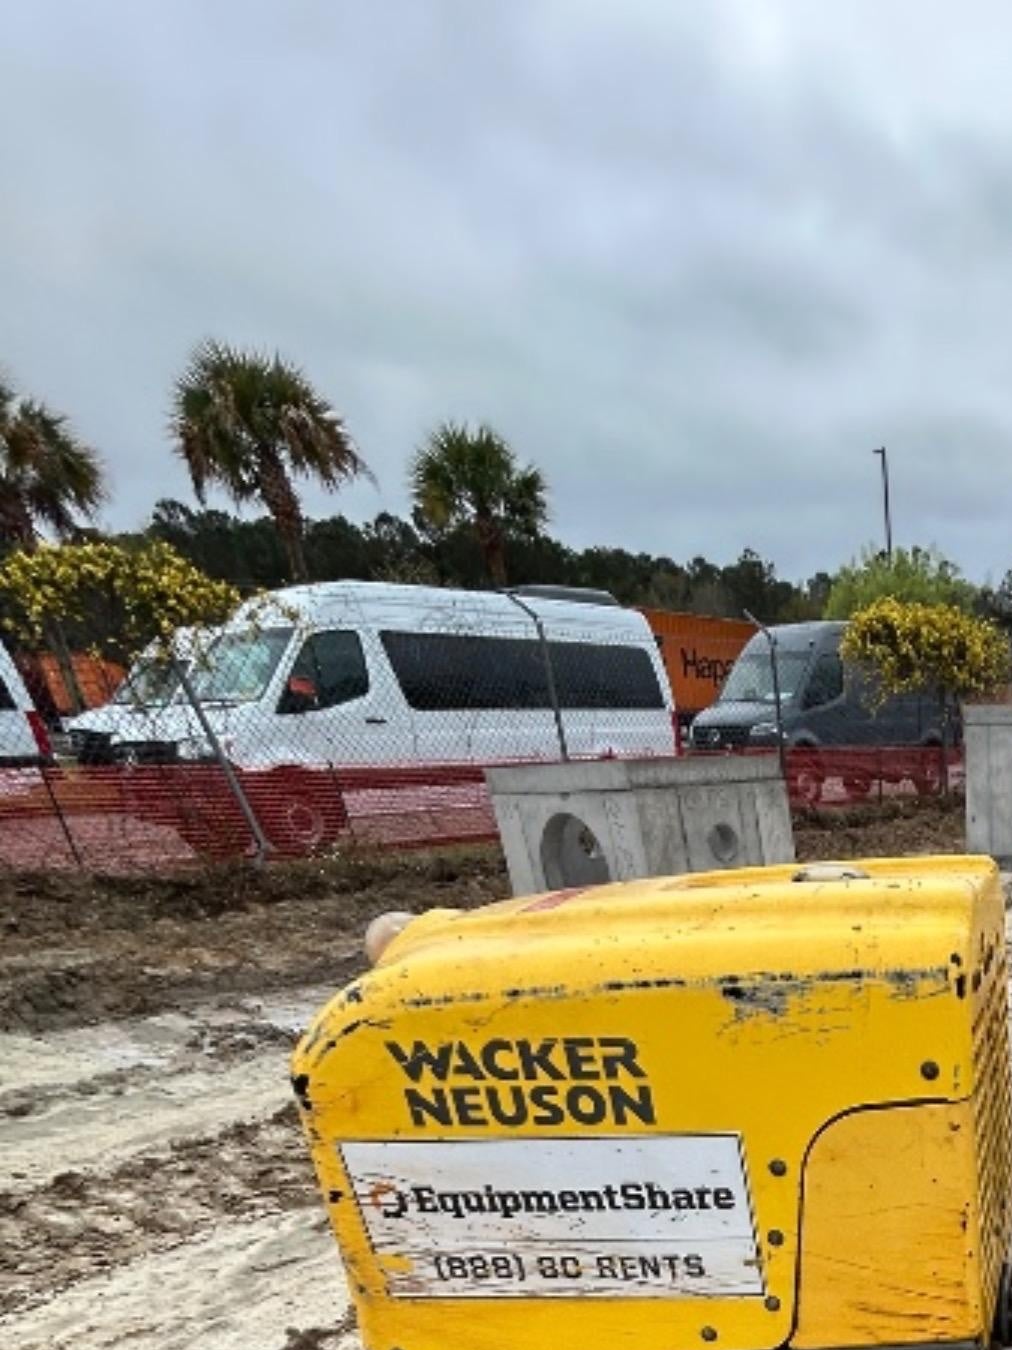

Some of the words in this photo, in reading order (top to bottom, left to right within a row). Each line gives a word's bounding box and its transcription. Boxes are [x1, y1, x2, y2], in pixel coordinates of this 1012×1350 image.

[384, 1037, 649, 1083] WACKER
[404, 1085, 657, 1127] NEUSON
[411, 1183, 736, 1219] EquipmentShare
[433, 1253, 526, 1282] (888)
[596, 1254, 706, 1281] RENTS
